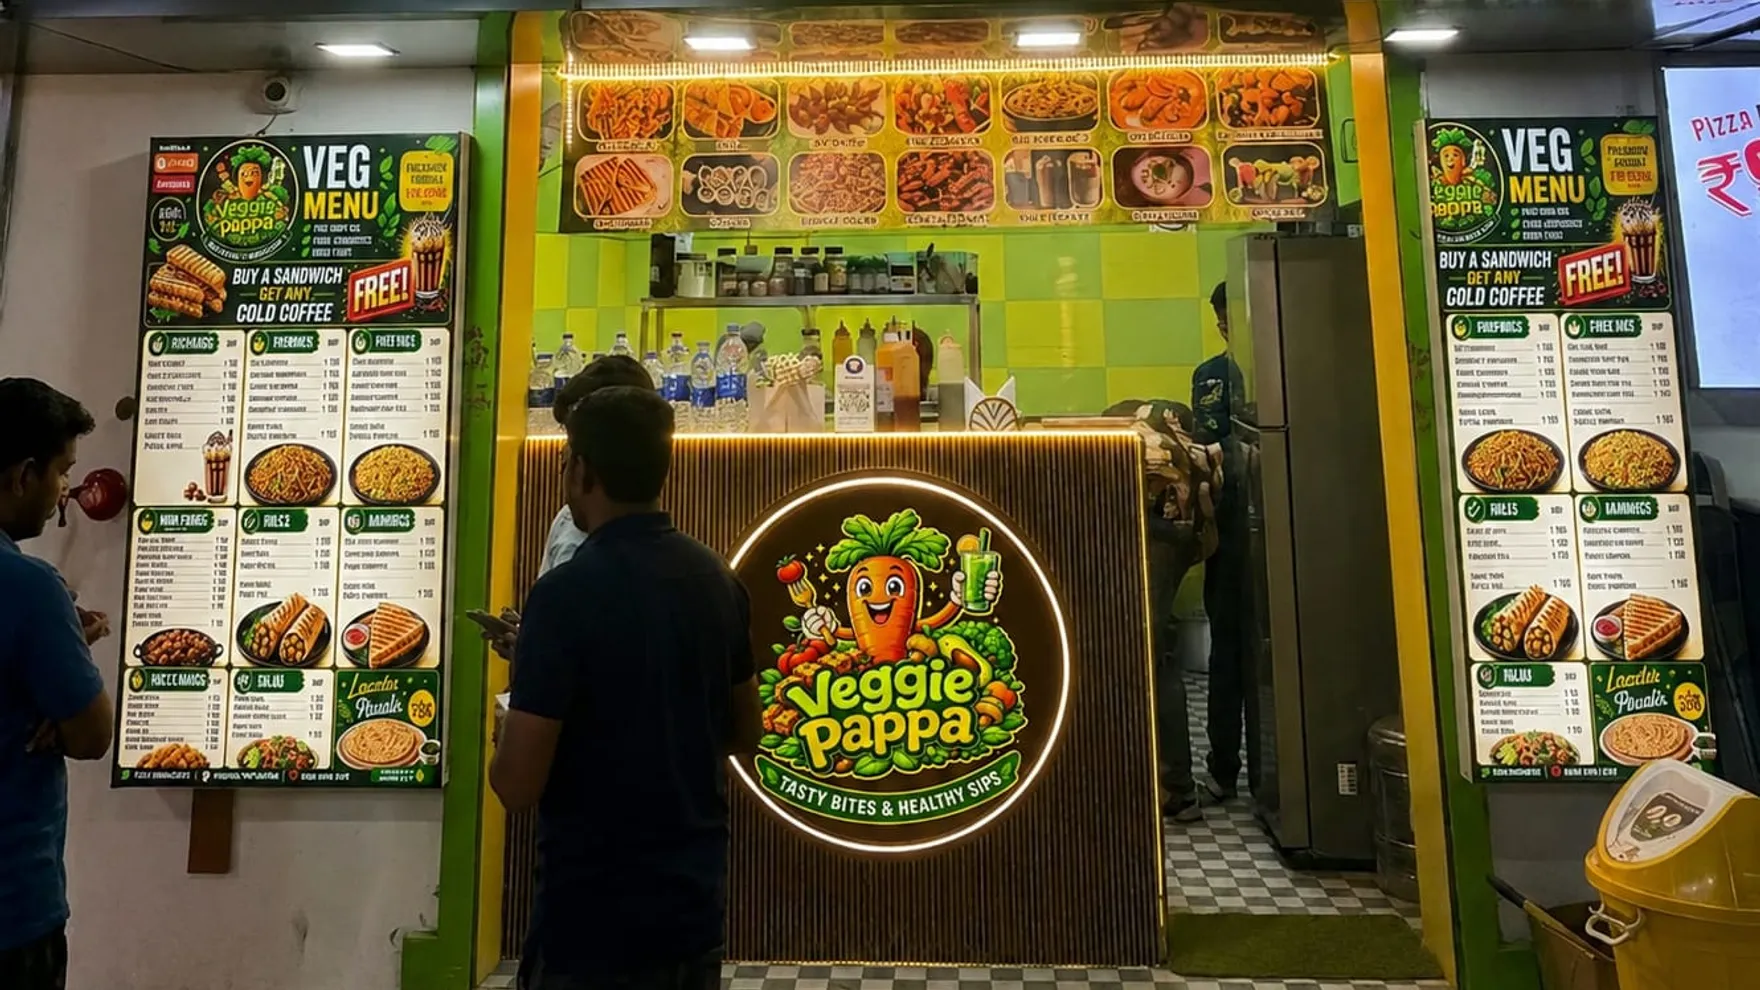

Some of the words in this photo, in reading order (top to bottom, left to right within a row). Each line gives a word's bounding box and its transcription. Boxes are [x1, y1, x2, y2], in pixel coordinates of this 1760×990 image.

[1692, 110, 1753, 141] PIZZA
[1502, 126, 1573, 173] VEG
[303, 144, 371, 189] VEG
[1510, 175, 1585, 204] MENU
[303, 191, 379, 220] MENU
[1439, 251, 1467, 269] BUY
[1469, 251, 1479, 269] A
[1481, 250, 1551, 269] SANDWICH
[232, 267, 260, 285] BUY
[261, 267, 271, 285] A
[272, 266, 343, 285] SANDWICH
[1467, 271, 1491, 285] GET
[1494, 270, 1521, 284] ANY
[1565, 250, 1624, 299] FREE!
[259, 286, 282, 301] GET
[283, 286, 312, 301] ANY
[354, 266, 409, 313] FREE!
[1447, 287, 1485, 307] COLD
[1489, 286, 1545, 306] COFFEE
[236, 304, 281, 323] COLD
[282, 303, 334, 322] COFFEE
[786, 658, 974, 718] Veggie
[779, 774, 828, 806] TASTY
[831, 798, 876, 816] BITES
[881, 803, 894, 817] &
[898, 785, 969, 816] HEALTHY
[969, 771, 1002, 798] SIPS
